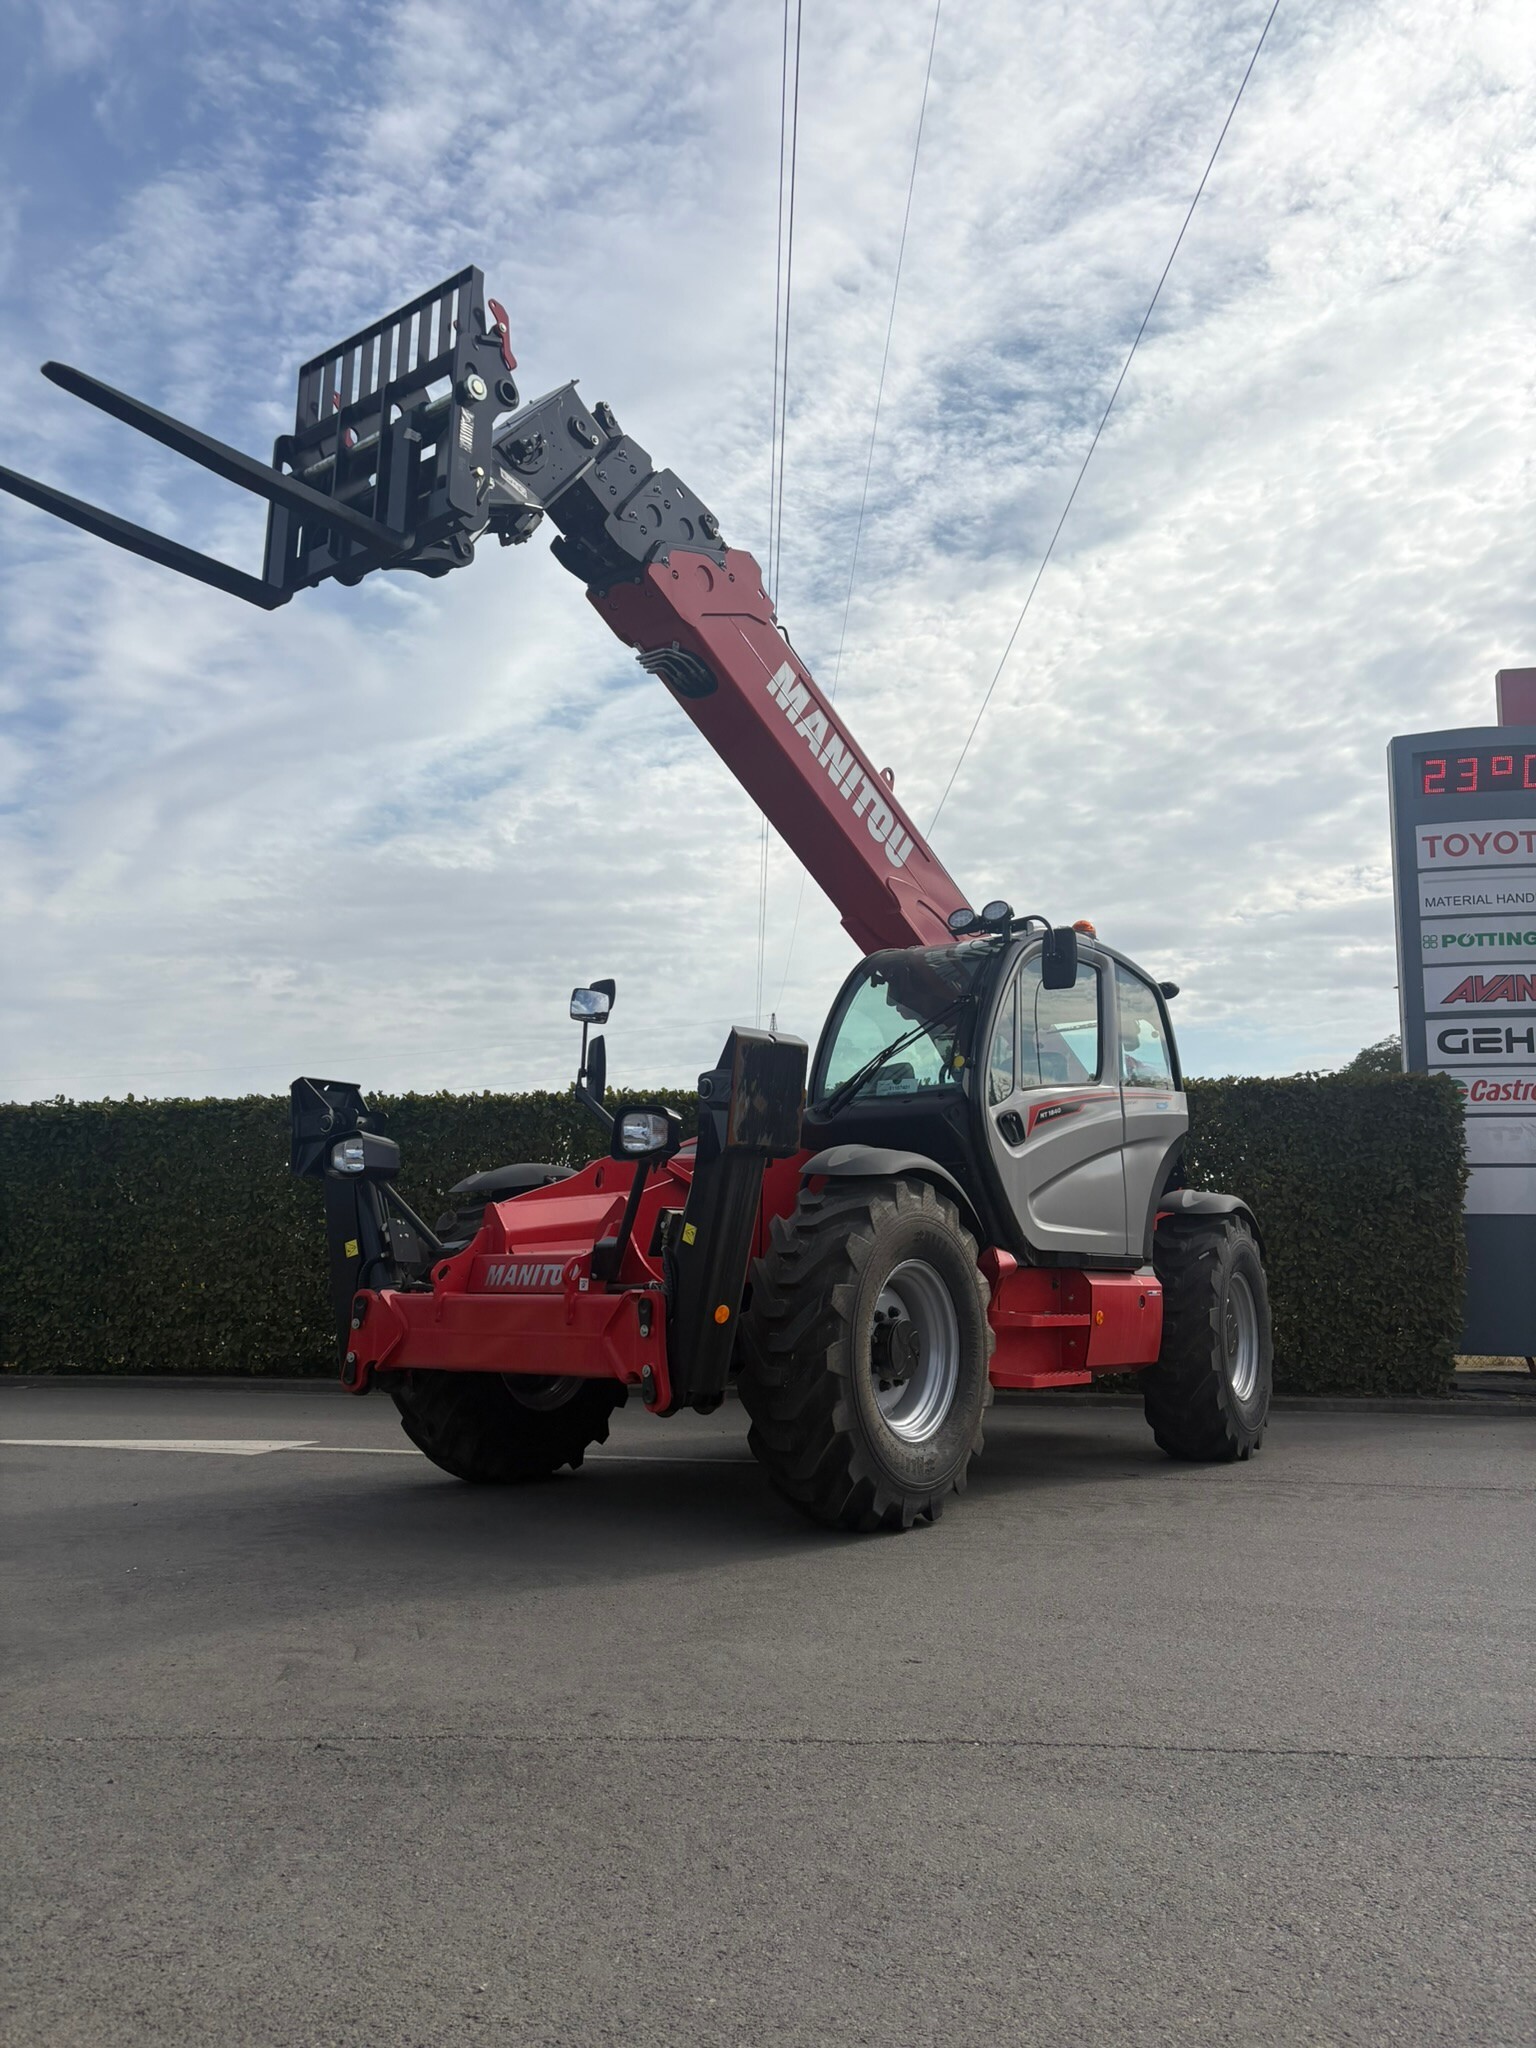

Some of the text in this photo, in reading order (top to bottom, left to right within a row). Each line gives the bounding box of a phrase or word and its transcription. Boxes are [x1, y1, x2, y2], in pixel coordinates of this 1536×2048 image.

[766, 660, 914, 868] MANITOU
[1422, 830, 1536, 858] TOYOT
[1425, 894, 1493, 908] MATERIAL
[1437, 1027, 1535, 1055] GEH
